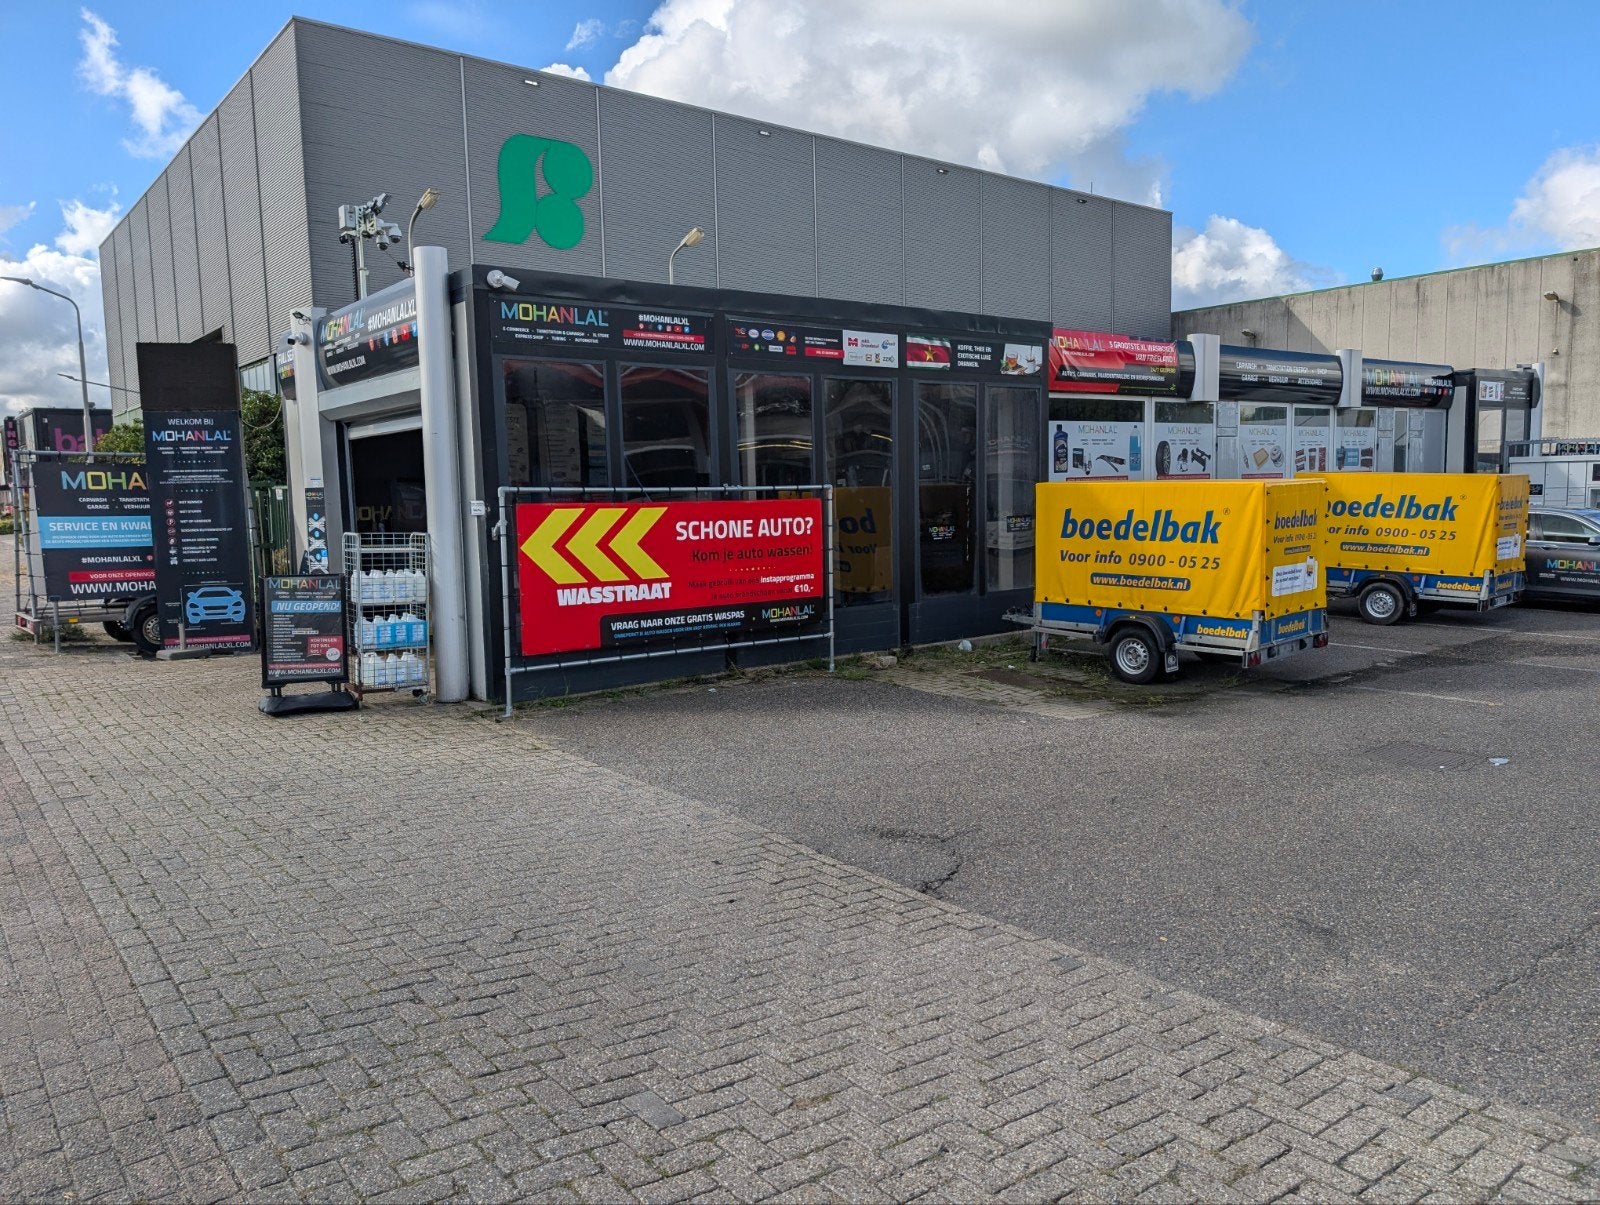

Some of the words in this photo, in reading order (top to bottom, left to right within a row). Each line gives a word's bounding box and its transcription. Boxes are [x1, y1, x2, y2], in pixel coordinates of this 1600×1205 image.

[501, 302, 609, 326] MOHANLAL
[638, 314, 690, 325] #MOHANLALXL
[623, 338, 705, 351] WWW.MOHANLALXL.COM
[1366, 368, 1420, 387] MOHANLAL
[152, 430, 232, 441] MOHANLAL
[1078, 425, 1118, 434] MOHANLAL
[1167, 425, 1201, 435] MOHANLAL
[60, 470, 149, 490] MOHA
[1328, 494, 1459, 521] oedelbak
[48, 522, 99, 531] SERVICE
[102, 522, 118, 531] EN
[675, 519, 753, 541] SCHONE
[757, 516, 814, 537] AUTO?
[1060, 508, 1222, 544] boedelbak
[1344, 525, 1369, 536] info
[1376, 527, 1409, 538] 0900
[692, 549, 720, 562] Kom
[723, 550, 734, 563] je
[737, 548, 764, 560] auto
[767, 544, 813, 558] wassen!
[1342, 543, 1427, 556] www.boedelbak.nl
[81, 555, 142, 564] #MOHANLALXL
[1060, 550, 1091, 563] Voor
[1094, 550, 1122, 564] info
[1128, 553, 1166, 566] 0900
[268, 579, 341, 590] MOHANLAL
[760, 572, 815, 584] instapprogramma
[1093, 574, 1188, 590] www.boedelbak.nl
[794, 584, 814, 593] €10,-
[1436, 580, 1481, 592] boedelbak
[556, 582, 672, 607] WASSTRAAT
[293, 602, 340, 611] GEOPEND!
[761, 604, 815, 619] MOHANLAL
[610, 620, 639, 631] VRAAG
[640, 619, 663, 629] NAAR
[664, 616, 685, 626] ONZE
[686, 614, 714, 624] GRATIS
[714, 610, 745, 620] WASPAS
[1197, 624, 1248, 638] boedelbak
